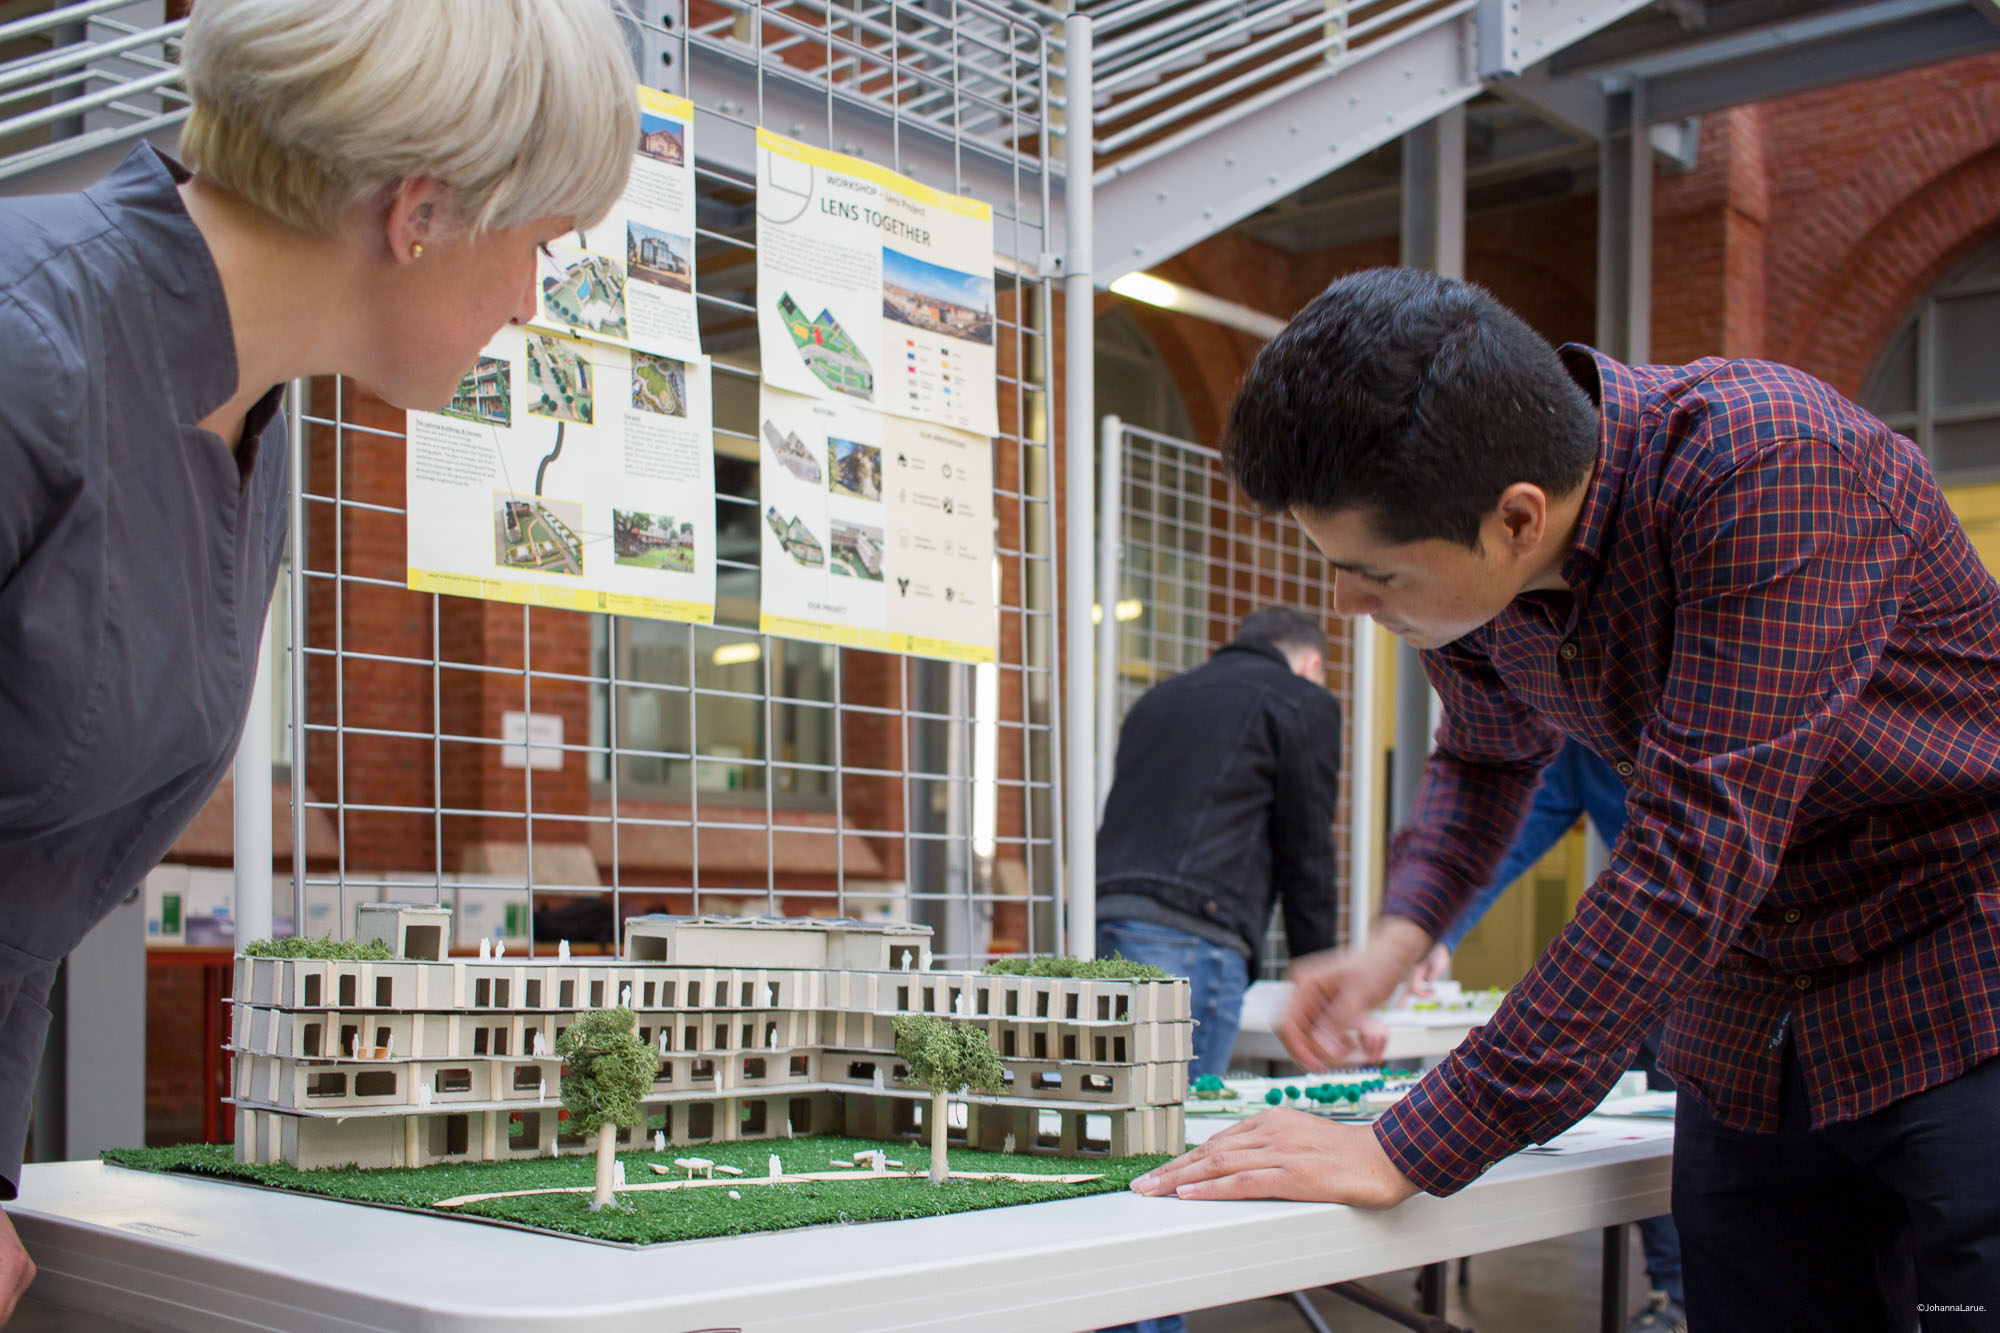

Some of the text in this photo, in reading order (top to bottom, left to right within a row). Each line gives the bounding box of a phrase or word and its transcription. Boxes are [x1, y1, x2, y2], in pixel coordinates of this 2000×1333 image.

[826, 175, 877, 195] WORKSHOP
[885, 192, 900, 207] Lens
[902, 200, 926, 217] Project
[821, 197, 931, 247] LENS TOGETHER
